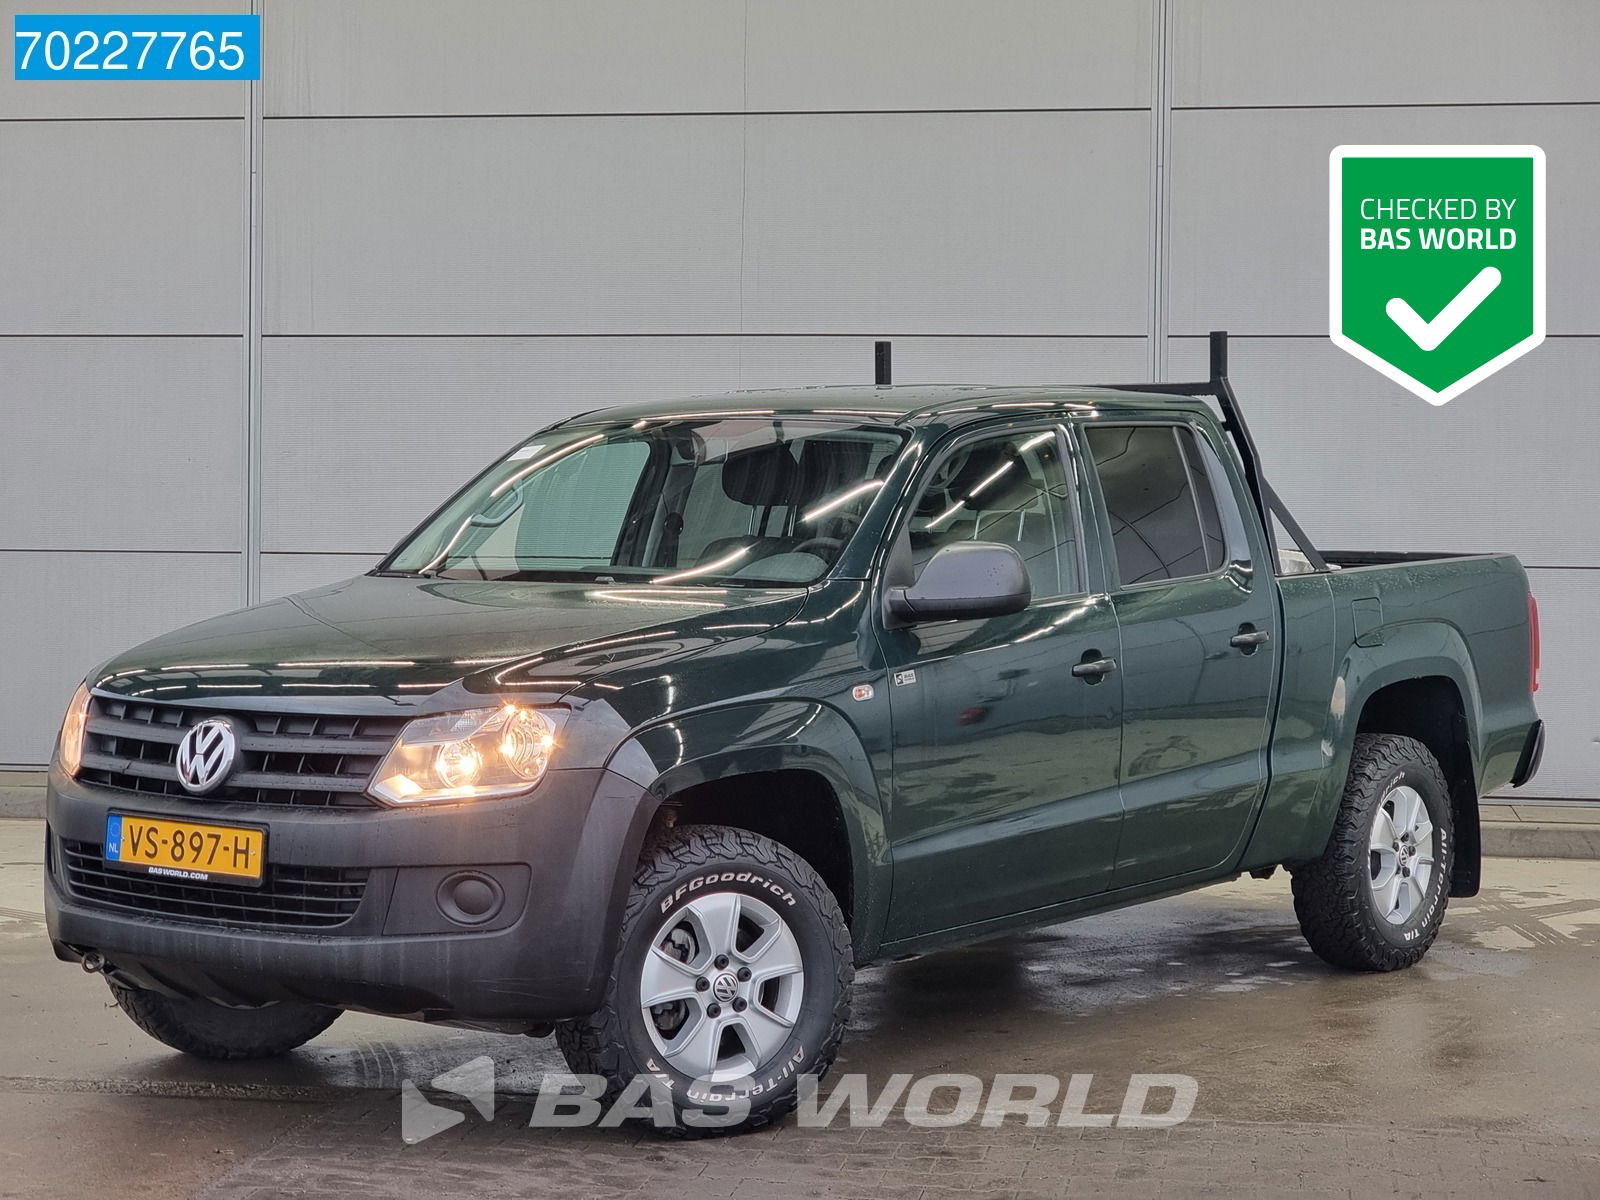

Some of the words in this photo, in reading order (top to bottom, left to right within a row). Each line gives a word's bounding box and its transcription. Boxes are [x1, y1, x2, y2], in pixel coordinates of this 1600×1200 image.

[108, 842, 119, 854] NL
[129, 825, 250, 869] VS-897-H
[660, 872, 797, 914] BFGoodrich
